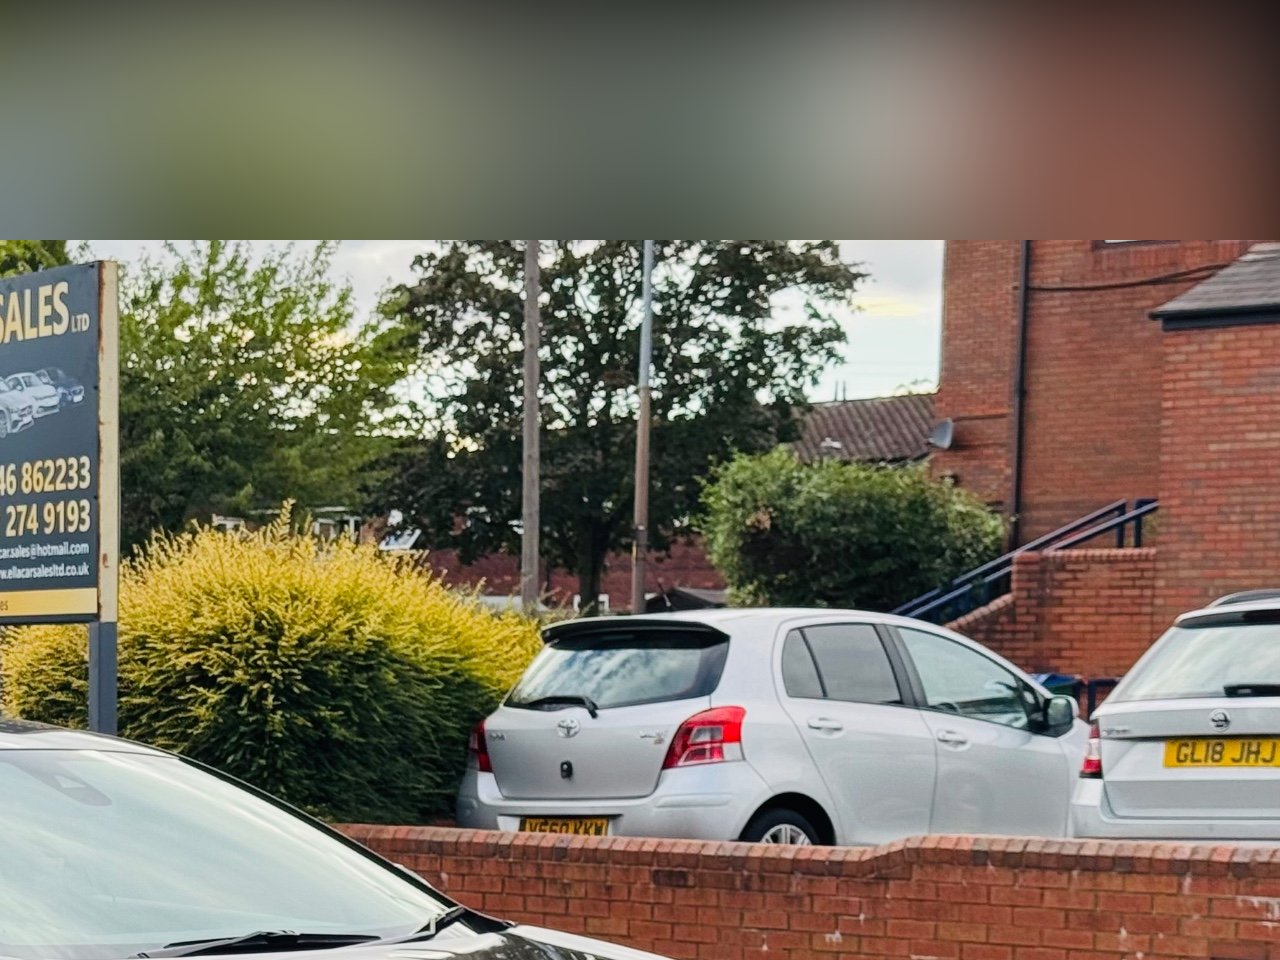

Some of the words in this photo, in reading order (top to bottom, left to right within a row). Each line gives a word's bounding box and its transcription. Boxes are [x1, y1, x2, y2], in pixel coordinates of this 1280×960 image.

[72, 313, 90, 332] LTD
[21, 456, 91, 494] 862233
[6, 503, 38, 537] 274
[43, 499, 91, 534] 9193
[1176, 741, 1223, 763] GL18
[1231, 741, 1276, 763] JHJ
